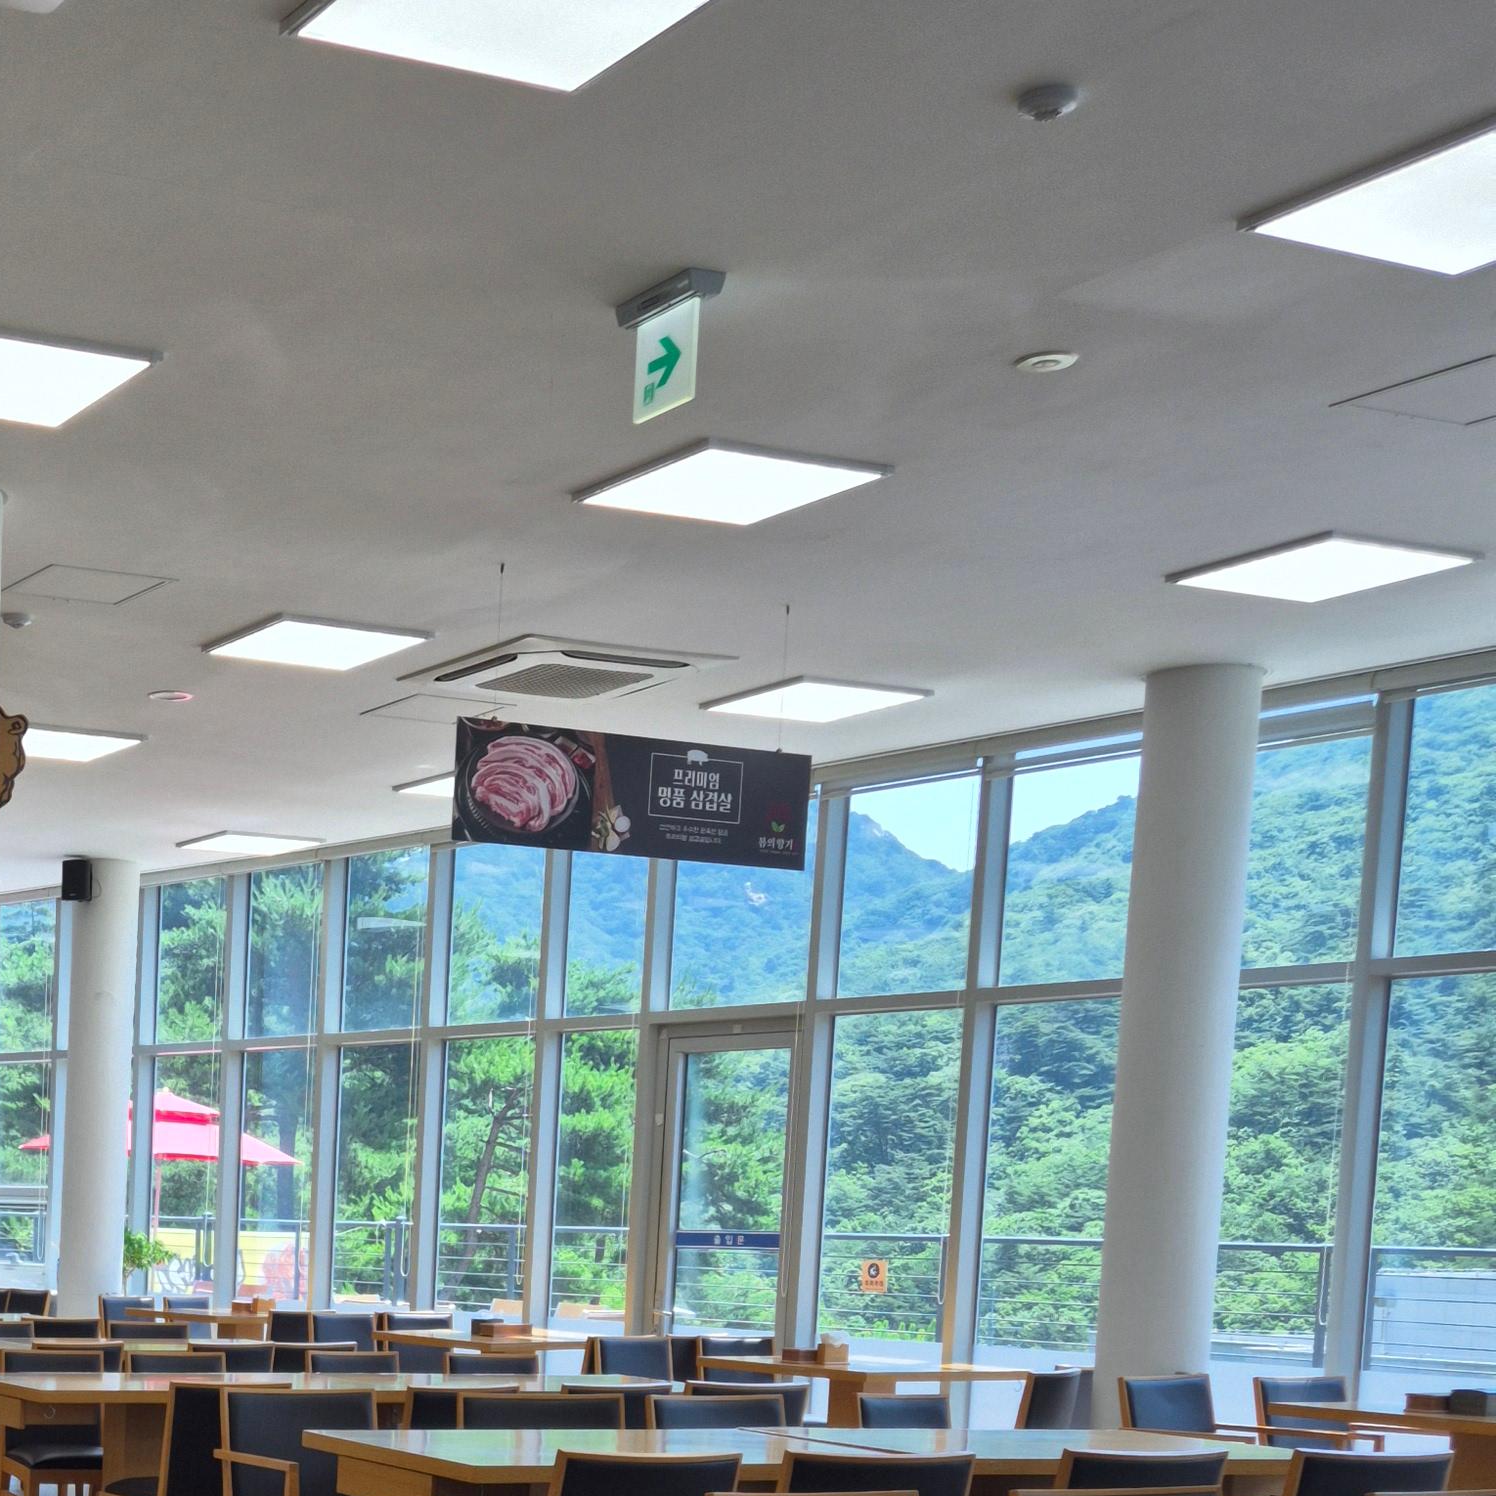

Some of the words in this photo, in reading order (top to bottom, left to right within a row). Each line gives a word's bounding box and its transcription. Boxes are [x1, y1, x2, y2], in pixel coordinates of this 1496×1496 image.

[672, 768, 720, 790] 프리미엄
[658, 786, 686, 808] 명품
[690, 790, 733, 813] 삼겹살
